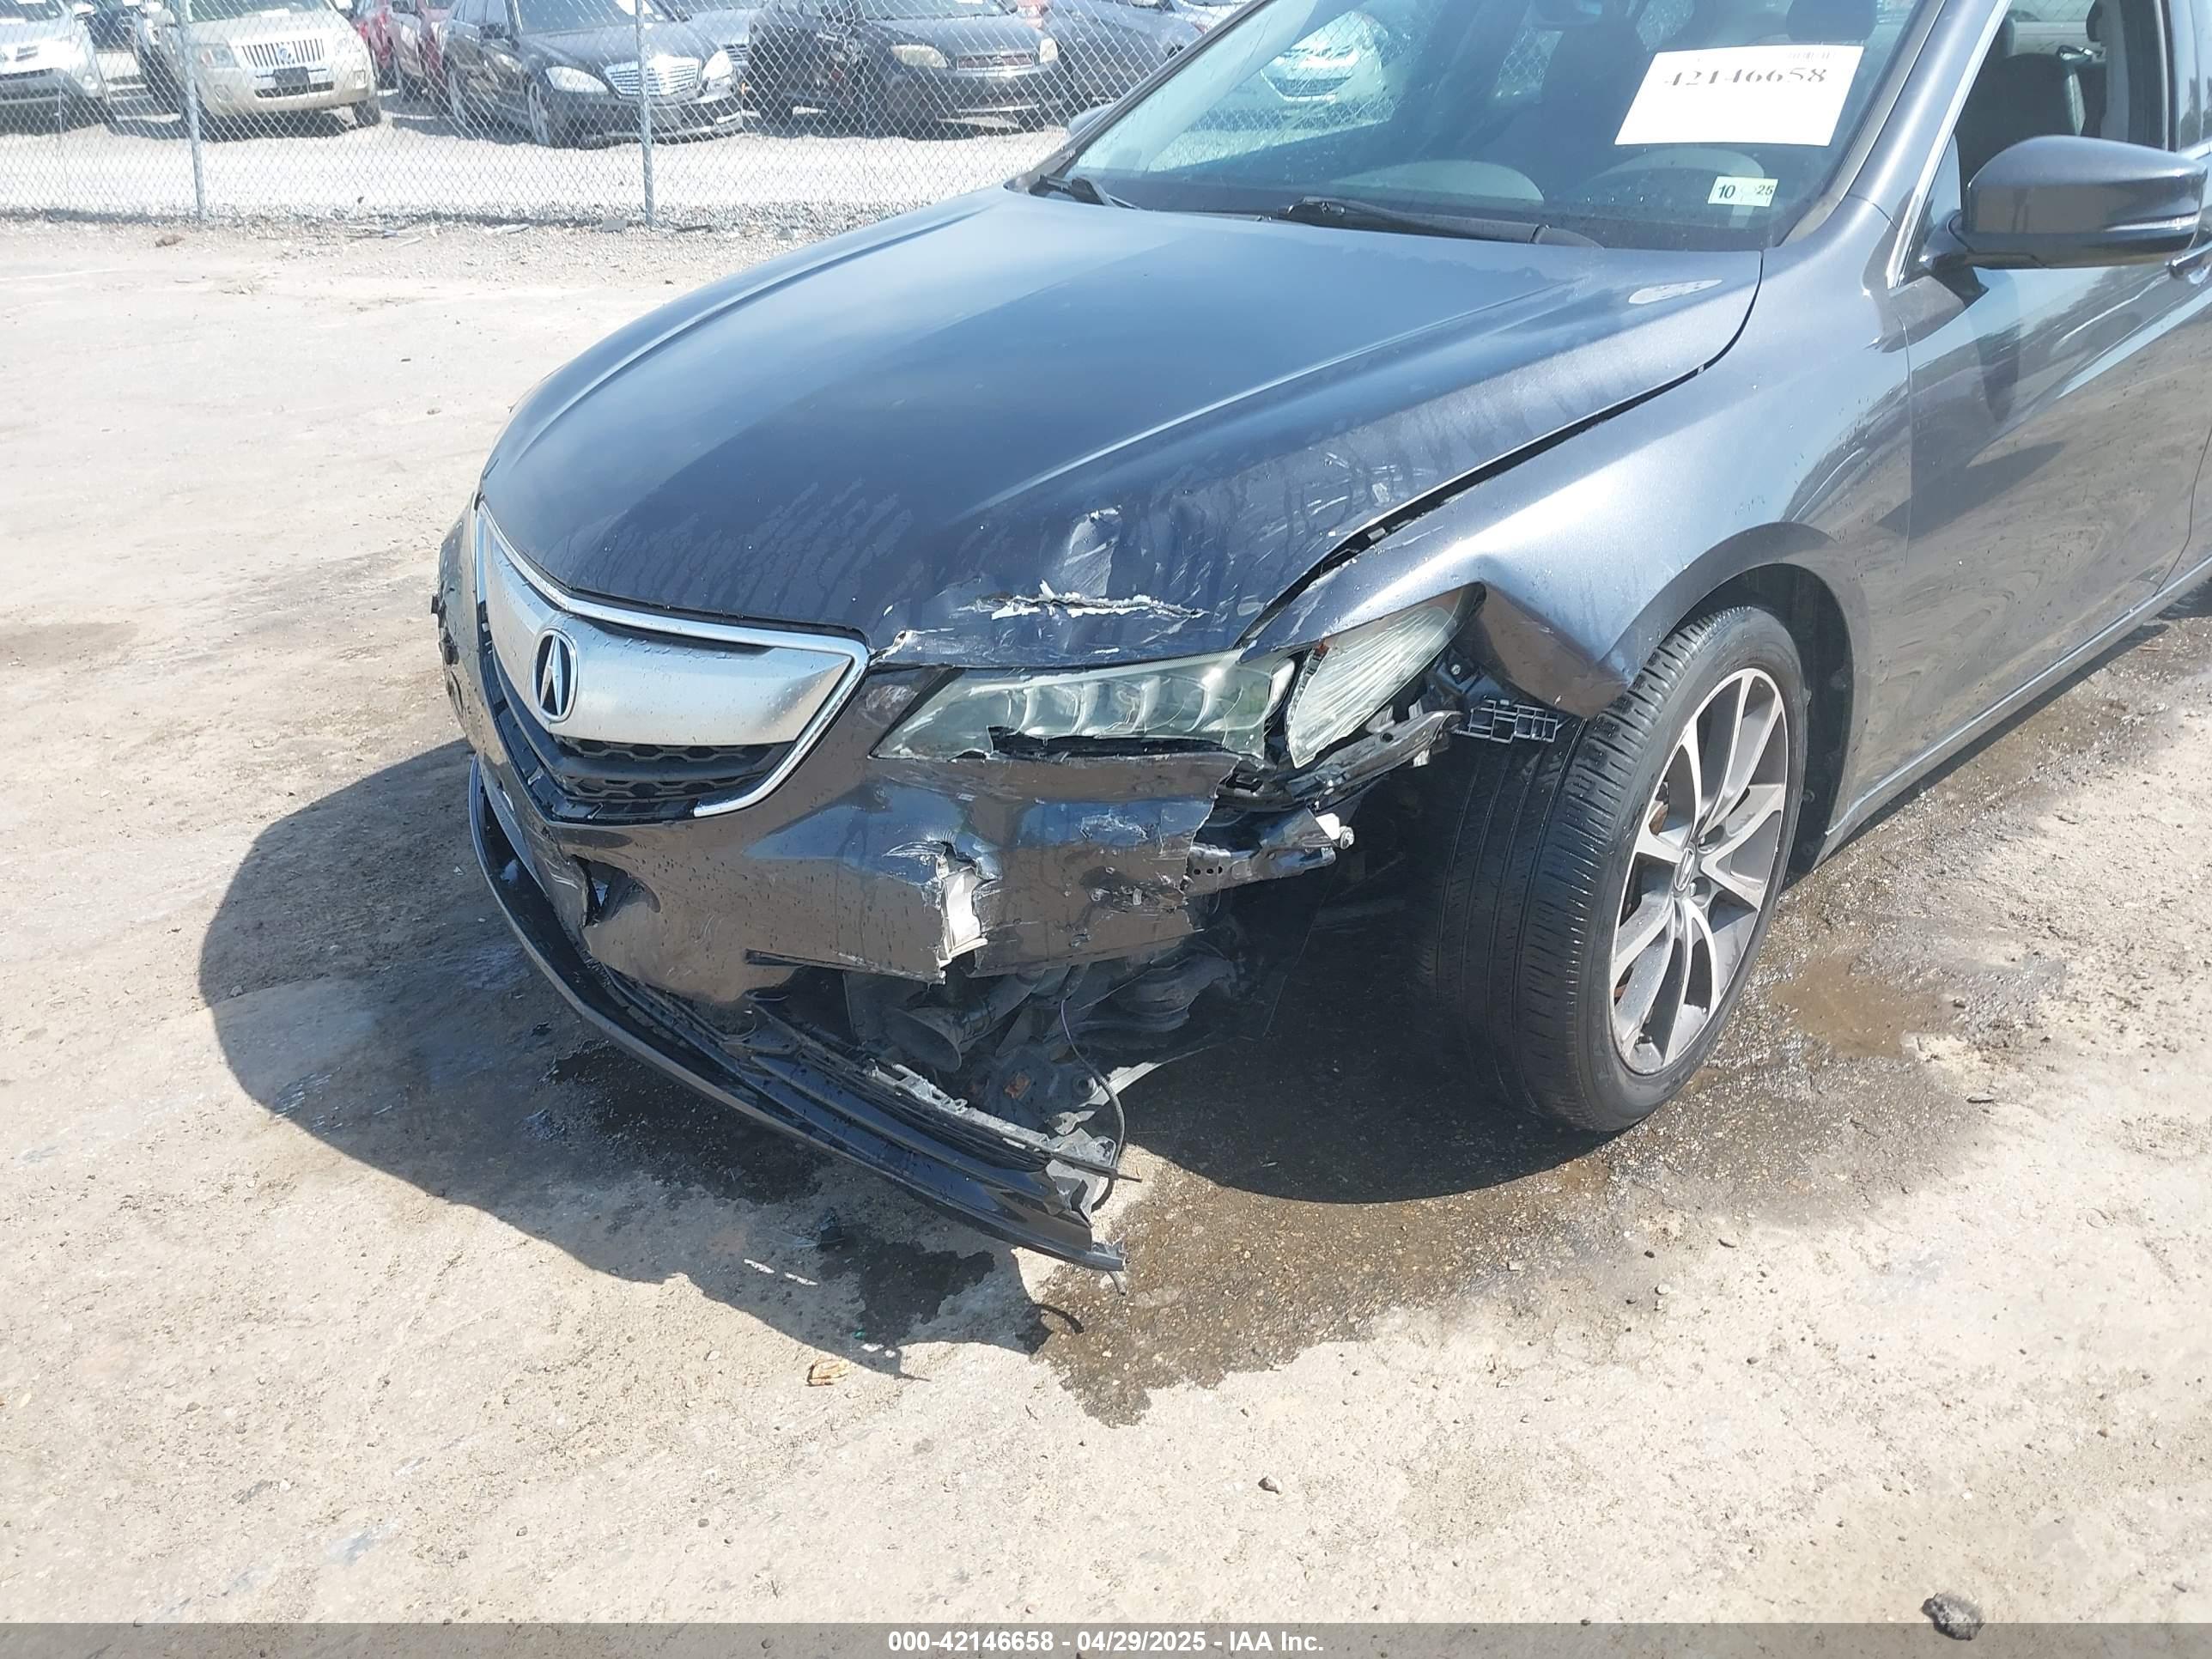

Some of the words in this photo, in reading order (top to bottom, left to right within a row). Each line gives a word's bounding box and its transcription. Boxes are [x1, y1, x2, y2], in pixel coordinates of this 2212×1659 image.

[1664, 68, 1827, 86] 42146658
[1717, 183, 1736, 199] 10
[1756, 185, 1774, 196] 25
